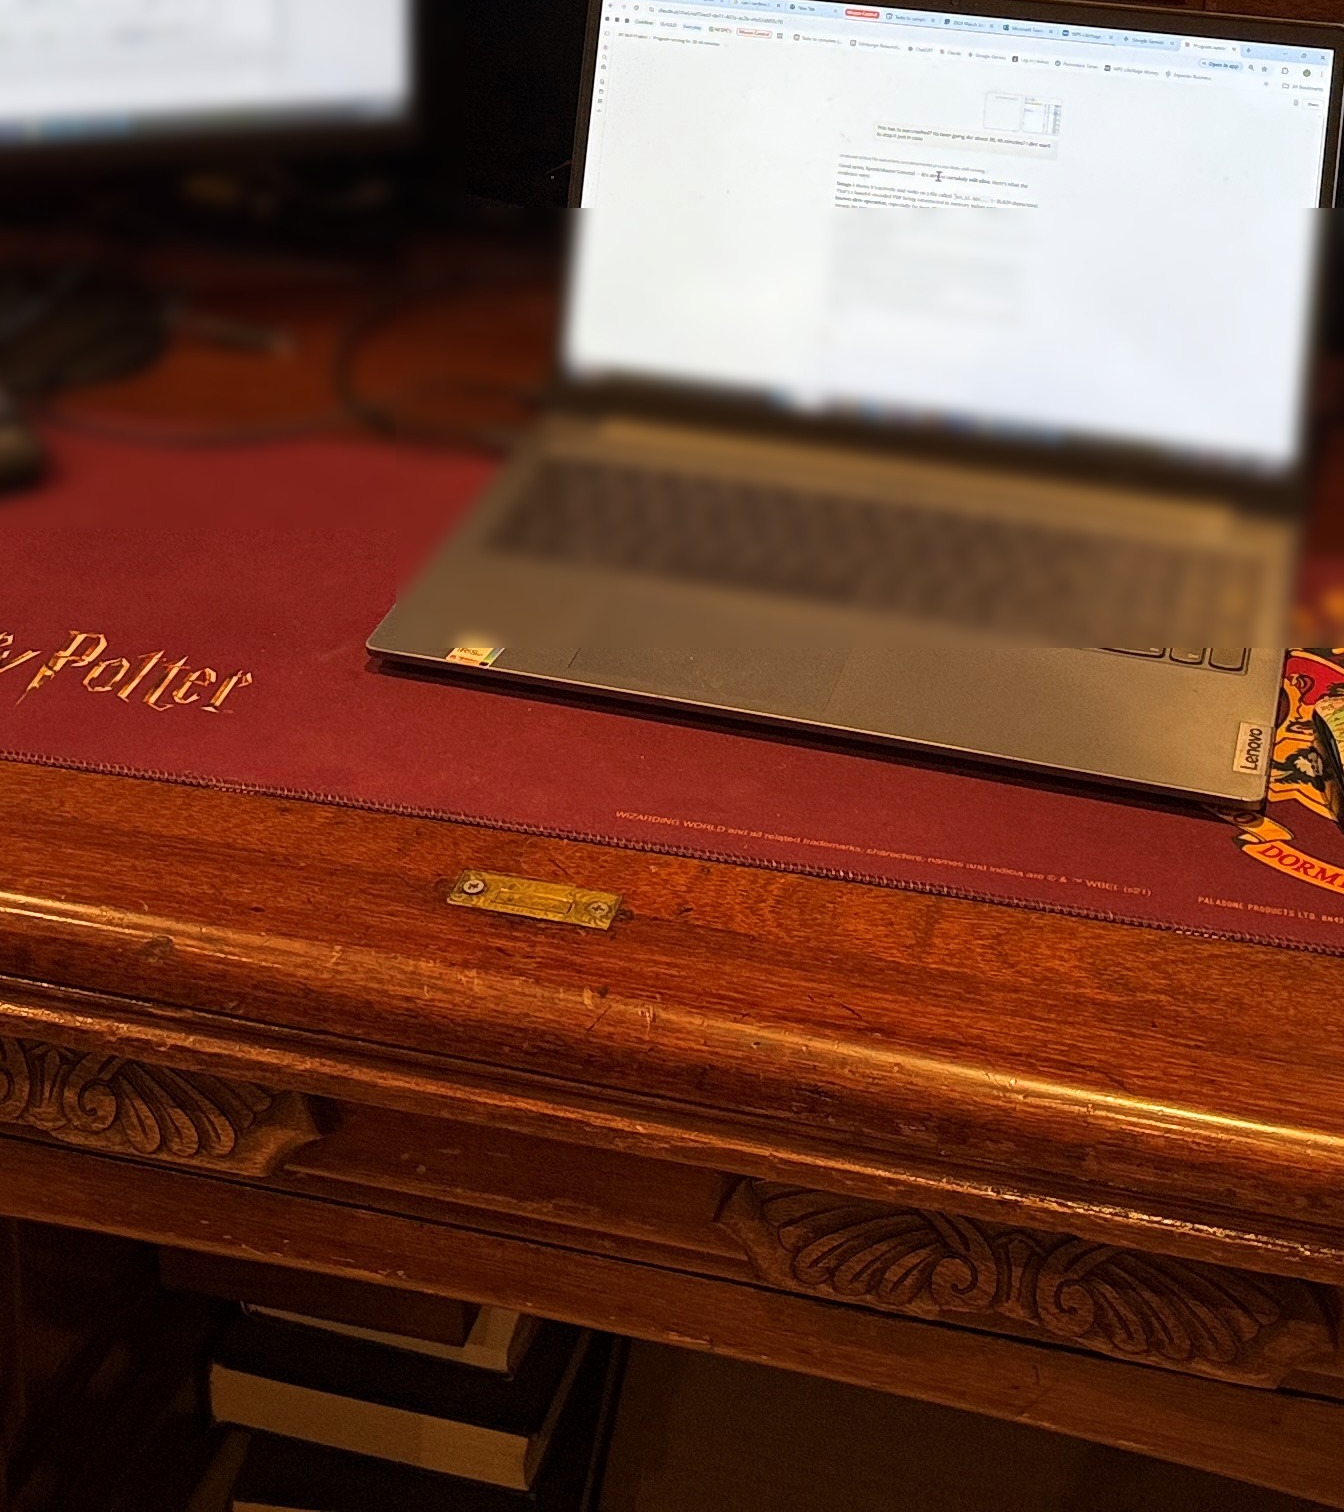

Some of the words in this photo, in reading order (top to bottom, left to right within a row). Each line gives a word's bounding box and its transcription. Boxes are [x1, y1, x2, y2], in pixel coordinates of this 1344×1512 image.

[15, 630, 253, 713] Potter
[1239, 727, 1263, 771] Lenovo
[616, 811, 680, 826] WIZARDING
[684, 821, 726, 833] WORLD
[728, 828, 748, 837] and
[928, 857, 964, 868] names
[966, 863, 987, 873] and
[1198, 895, 1244, 910] PALADONE
[1248, 903, 1295, 918] PRODUCTS
